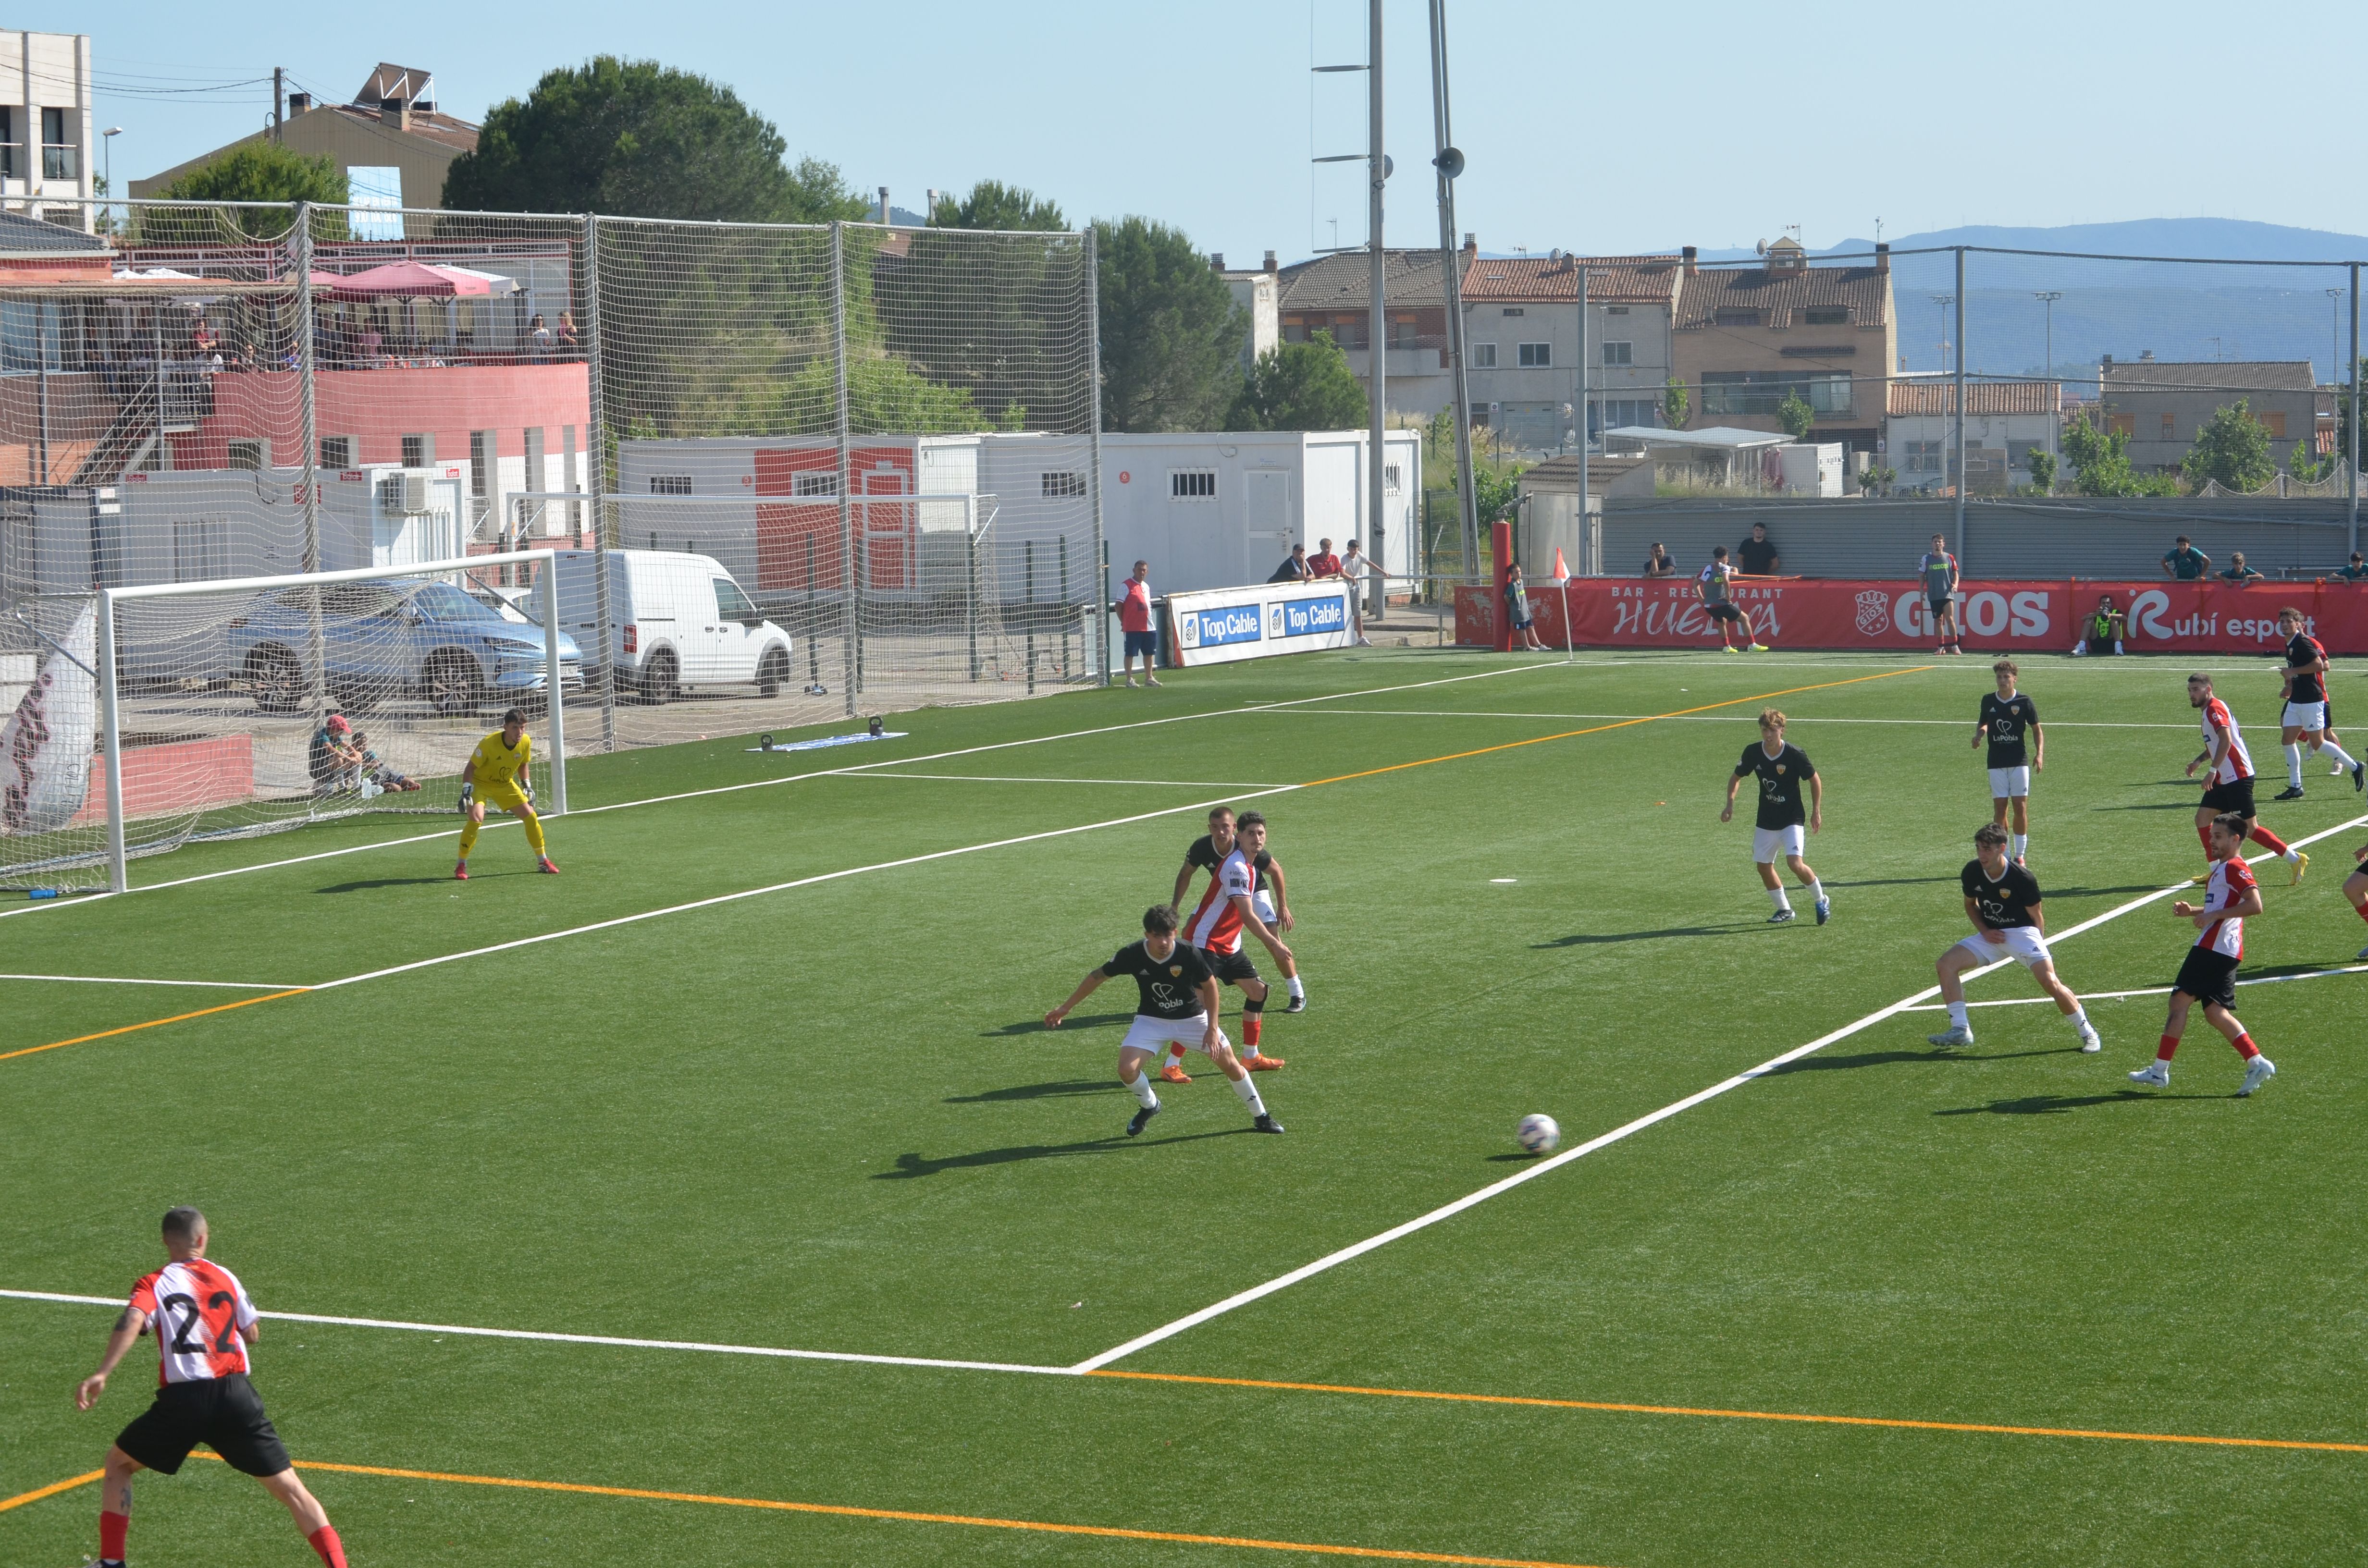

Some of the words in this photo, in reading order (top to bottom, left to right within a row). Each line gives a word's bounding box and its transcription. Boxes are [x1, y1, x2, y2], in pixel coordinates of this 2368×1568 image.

[1612, 587, 1643, 597] BAR
[1669, 588, 1783, 599] RESURANT
[1202, 617, 1226, 641] Top
[1226, 612, 1258, 635] Cable
[1288, 608, 1307, 631] Top
[1309, 604, 1342, 625] Cable
[1860, 604, 1883, 625] GIOS
[1894, 591, 2050, 637] GIOS
[163, 1290, 236, 1354] 22
